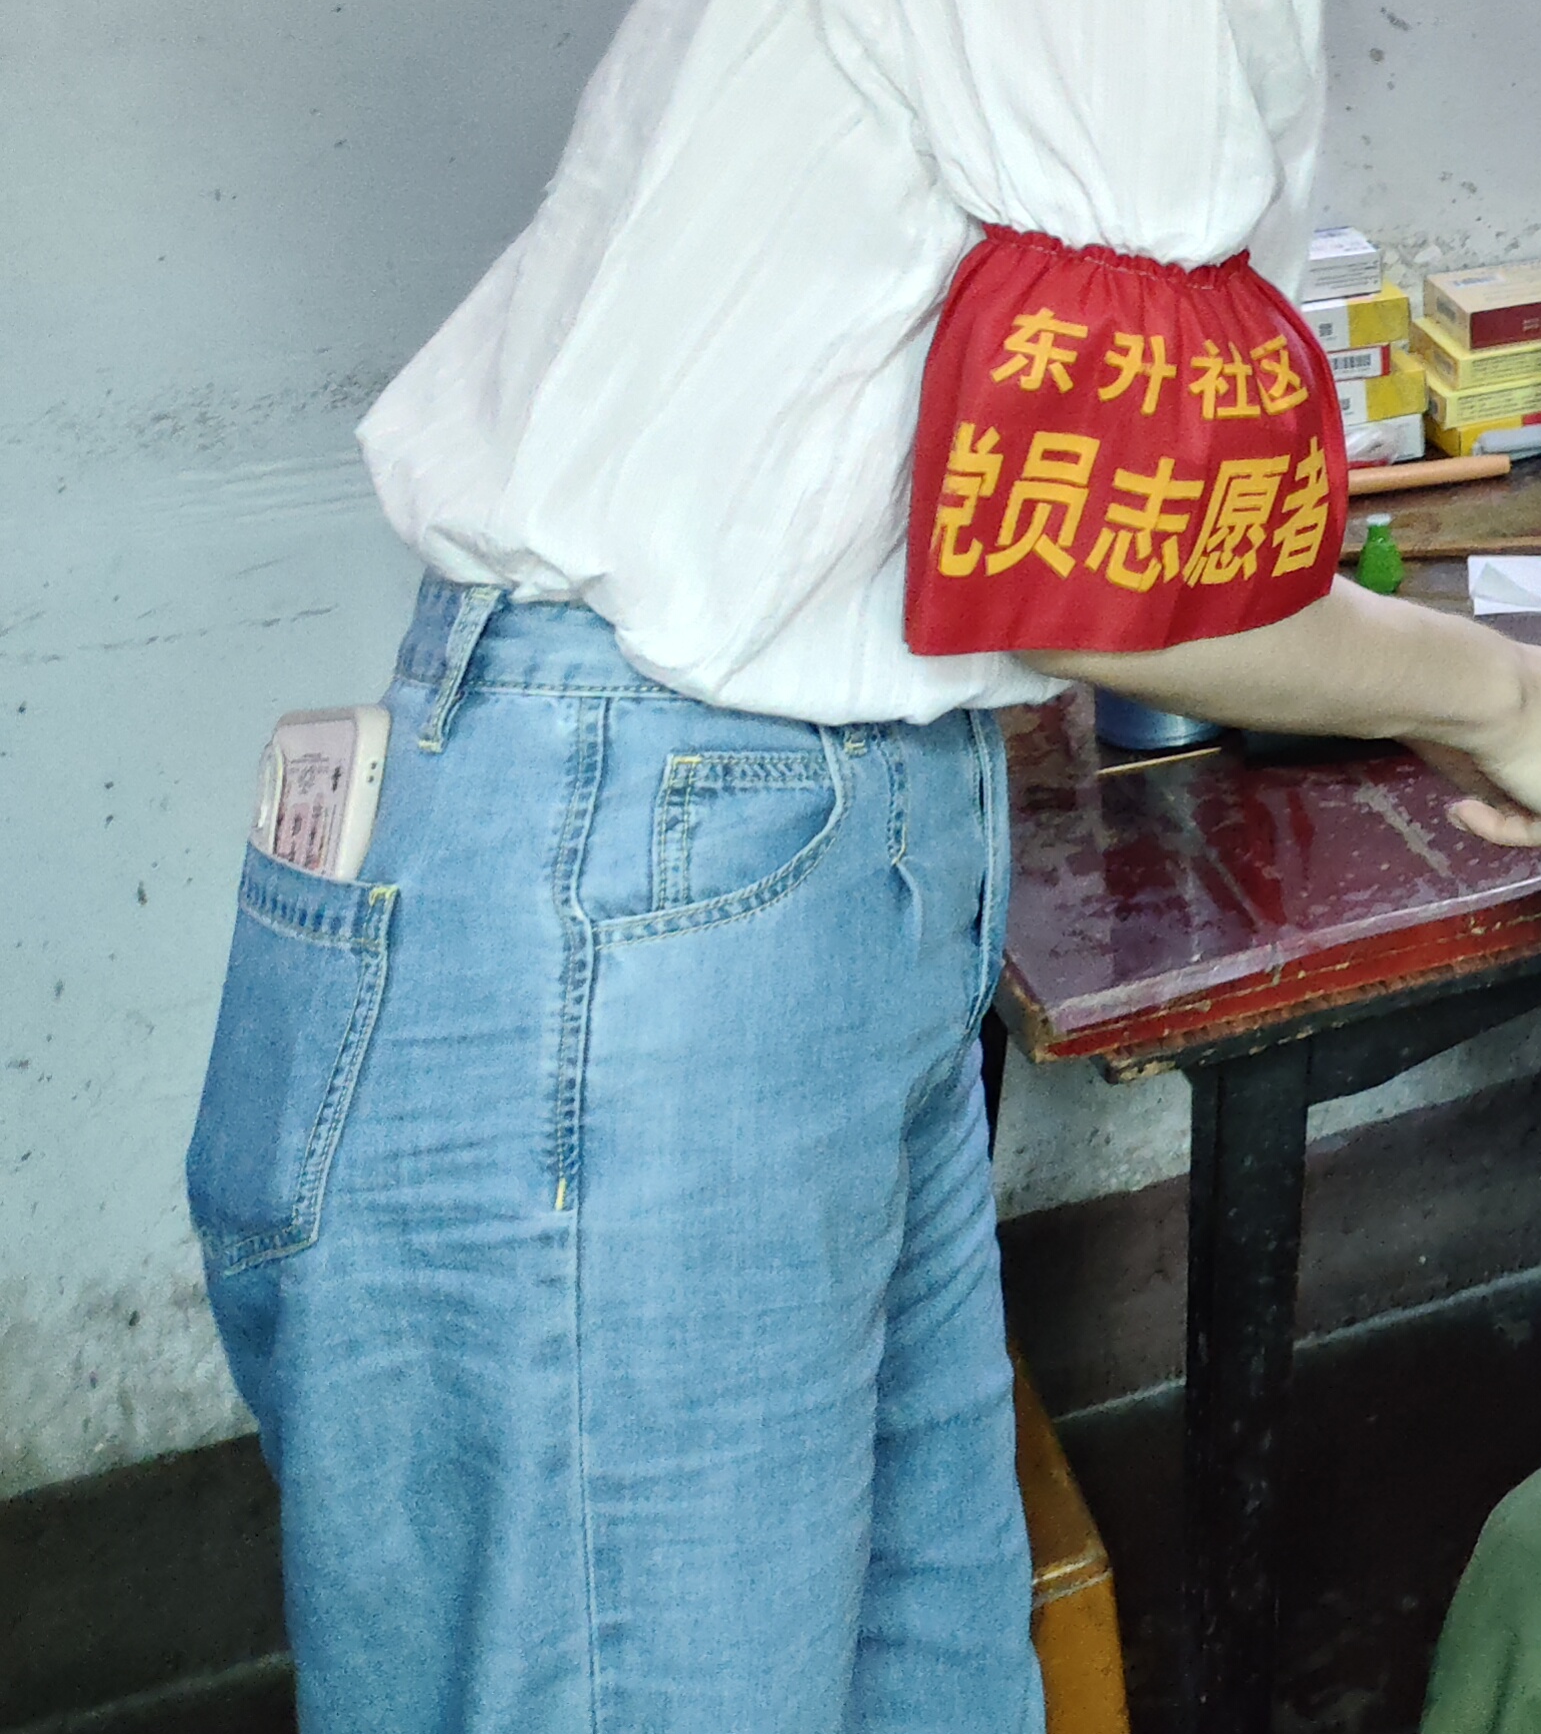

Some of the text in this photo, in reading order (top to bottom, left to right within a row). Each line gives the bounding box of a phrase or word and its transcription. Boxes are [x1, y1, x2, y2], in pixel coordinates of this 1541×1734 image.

[991, 308, 1310, 421] 东升社区
[931, 421, 1331, 594] 党员志愿者
